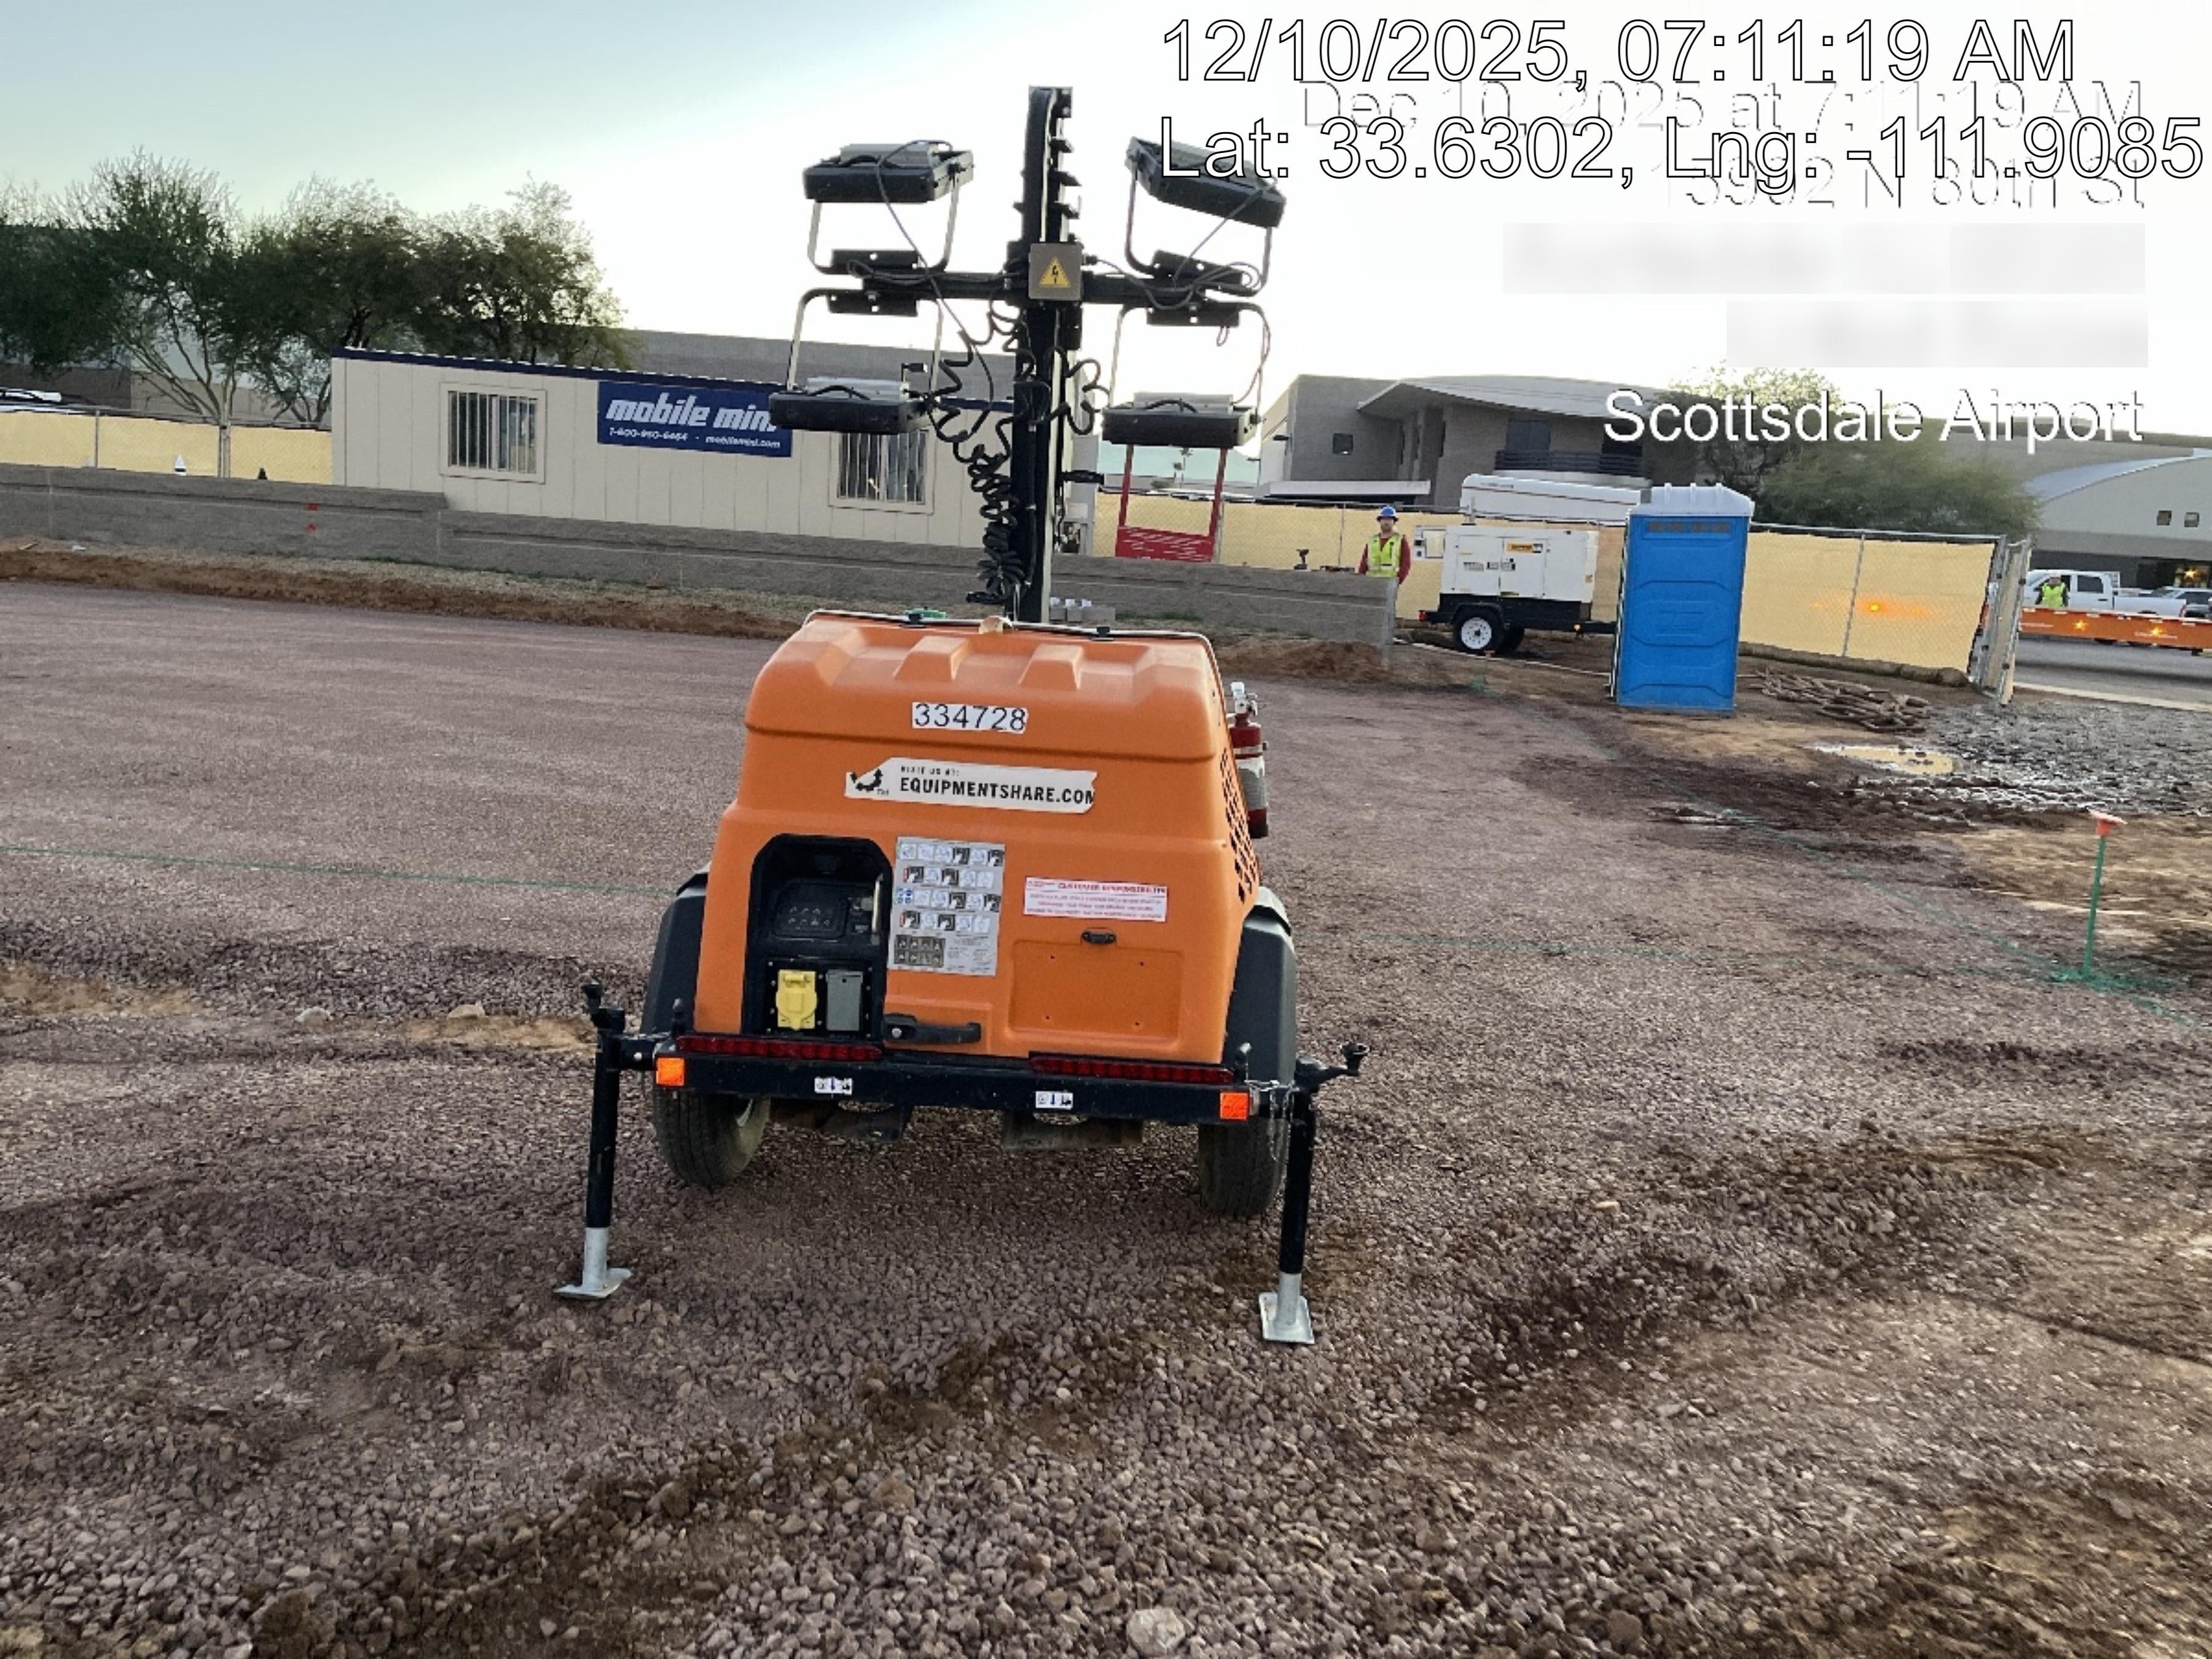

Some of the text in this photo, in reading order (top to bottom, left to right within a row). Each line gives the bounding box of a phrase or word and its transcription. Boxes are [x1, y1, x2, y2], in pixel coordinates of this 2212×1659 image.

[605, 392, 777, 433] mobile min
[914, 704, 1026, 731] 334728
[900, 777, 1095, 805] EQUIPMENTSHARE.COM
